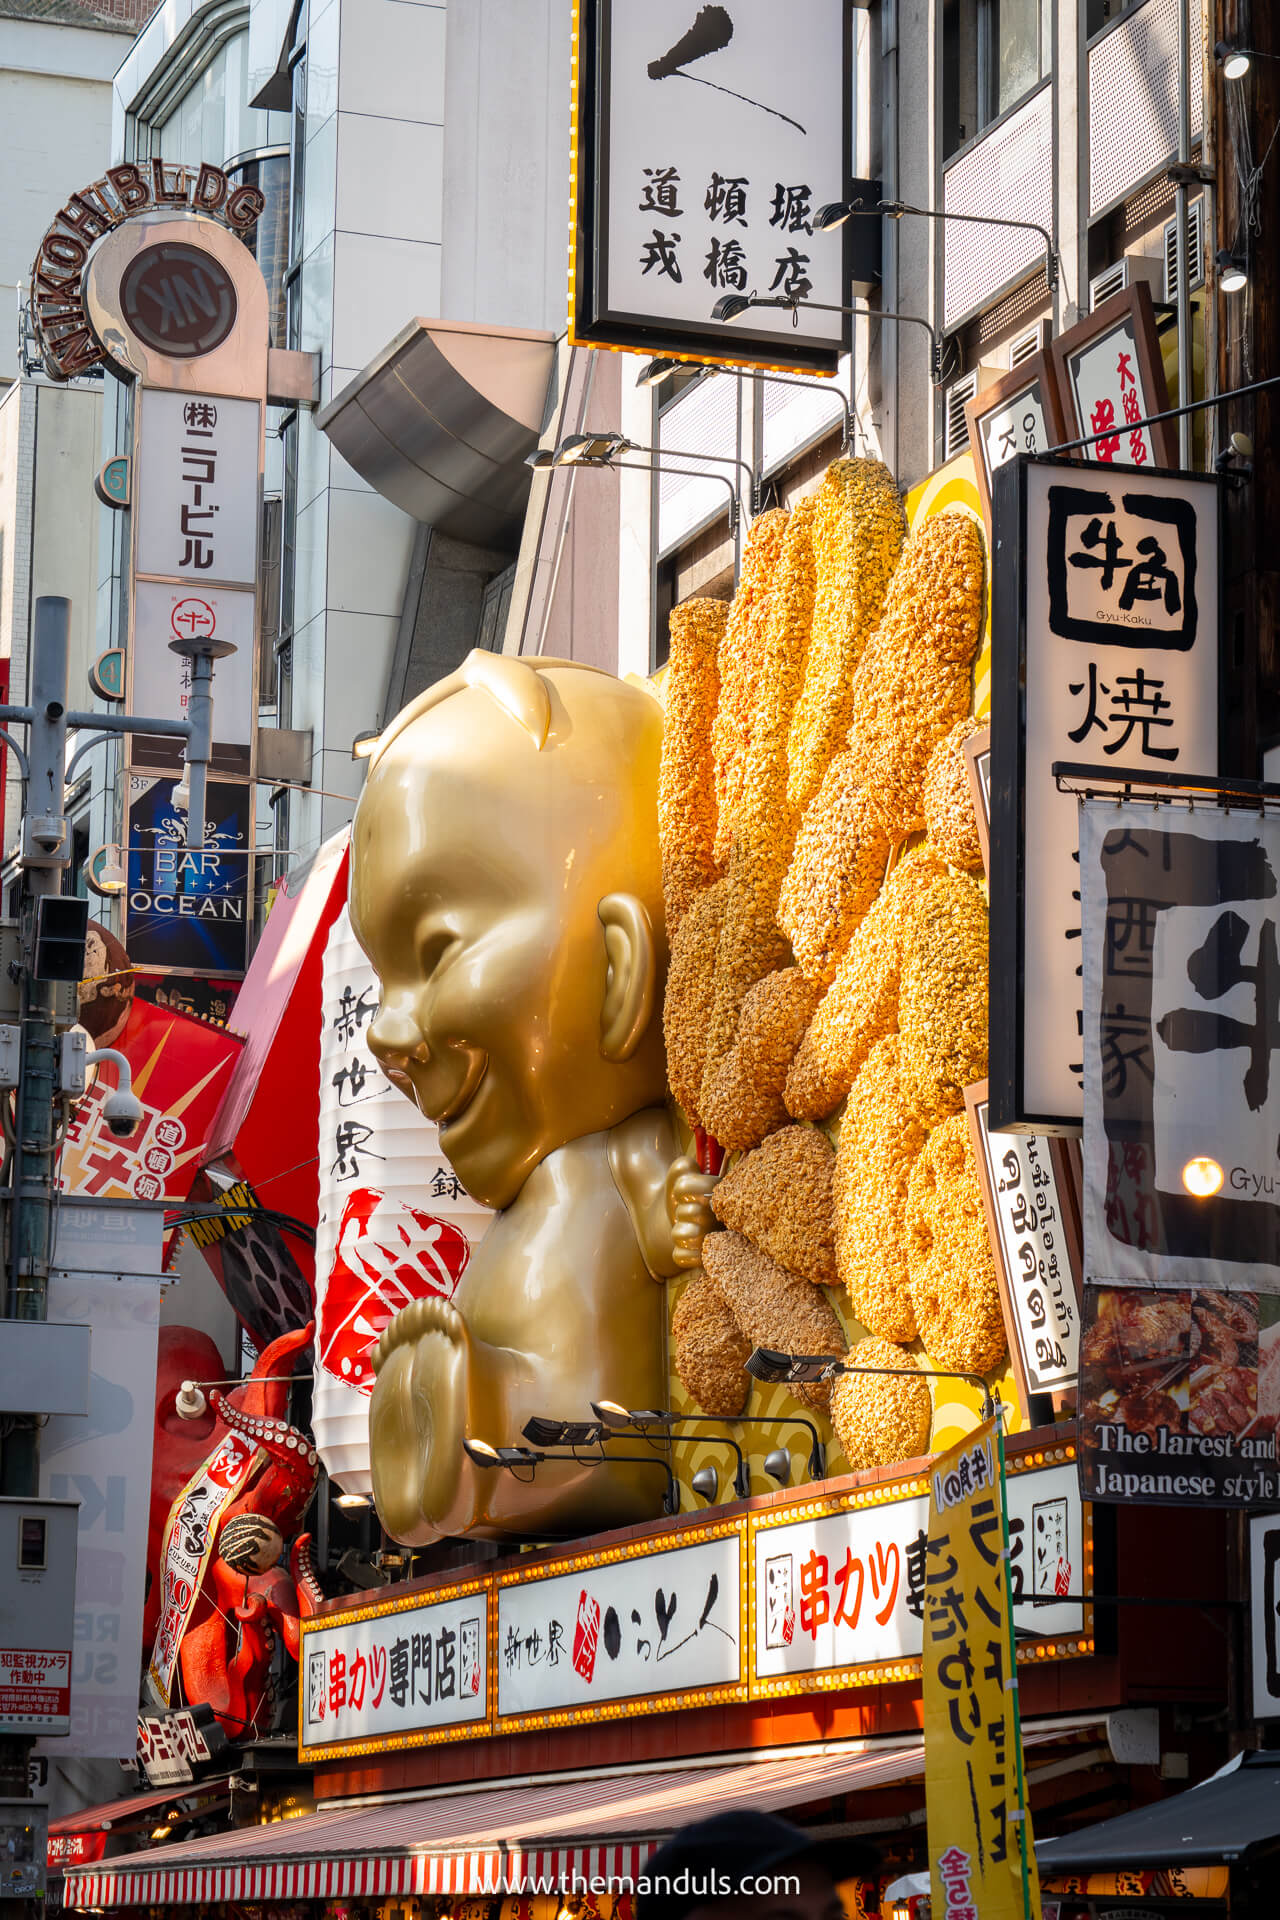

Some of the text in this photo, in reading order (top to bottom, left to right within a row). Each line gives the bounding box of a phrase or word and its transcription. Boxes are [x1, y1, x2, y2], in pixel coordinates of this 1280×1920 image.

[106, 157, 266, 229] BLDG
[638, 167, 813, 236] 道頓堀
[638, 230, 813, 299] 戎橋店
[108, 468, 123, 491] 5
[1068, 517, 1181, 616] 牛角
[1096, 610, 1152, 626] Gyu-Kaku
[102, 660, 118, 684] 4
[130, 776, 149, 790] 3F
[155, 849, 221, 877] BAR
[130, 891, 242, 920] OCEAN
[135, 1121, 181, 1200] 道頓堀
[1095, 1424, 1275, 1459] The larest and
[1095, 1463, 1274, 1501] Japanese style
[504, 1618, 567, 1677] 新世界
[10, 1669, 46, 1685] 作動中
[328, 1625, 457, 1720] 串カツ専門店
